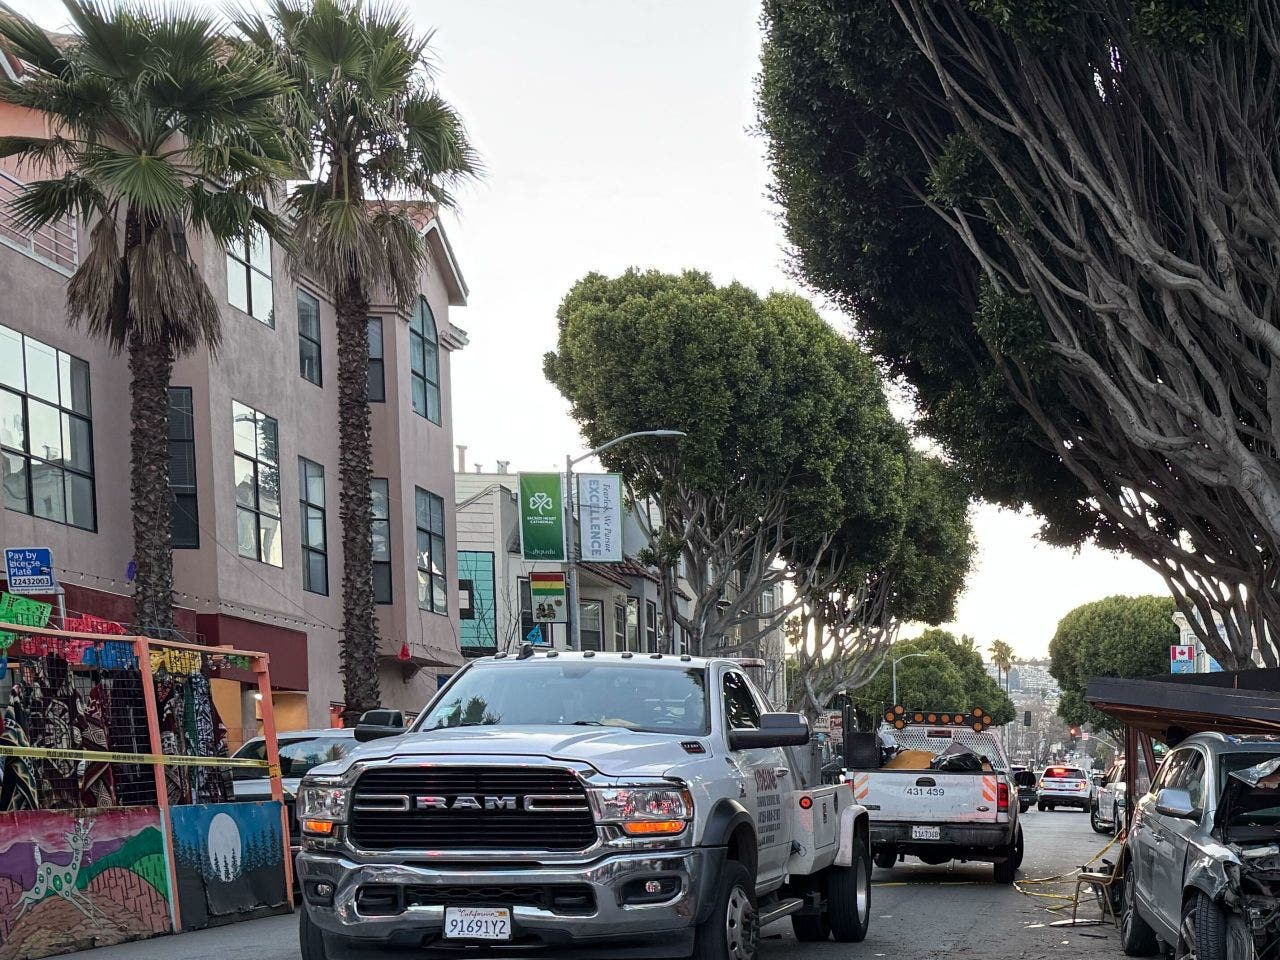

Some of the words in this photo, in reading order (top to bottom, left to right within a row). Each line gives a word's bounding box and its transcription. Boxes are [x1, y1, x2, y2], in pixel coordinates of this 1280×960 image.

[589, 480, 601, 556] EXCELLENCE
[8, 552, 23, 560] Pay
[26, 551, 36, 560] by
[13, 577, 49, 585] 22432003
[907, 788, 923, 796] 431
[927, 788, 945, 796] 439
[416, 796, 516, 809] RAM
[458, 909, 495, 918] California
[450, 919, 507, 934] 91691Y2
